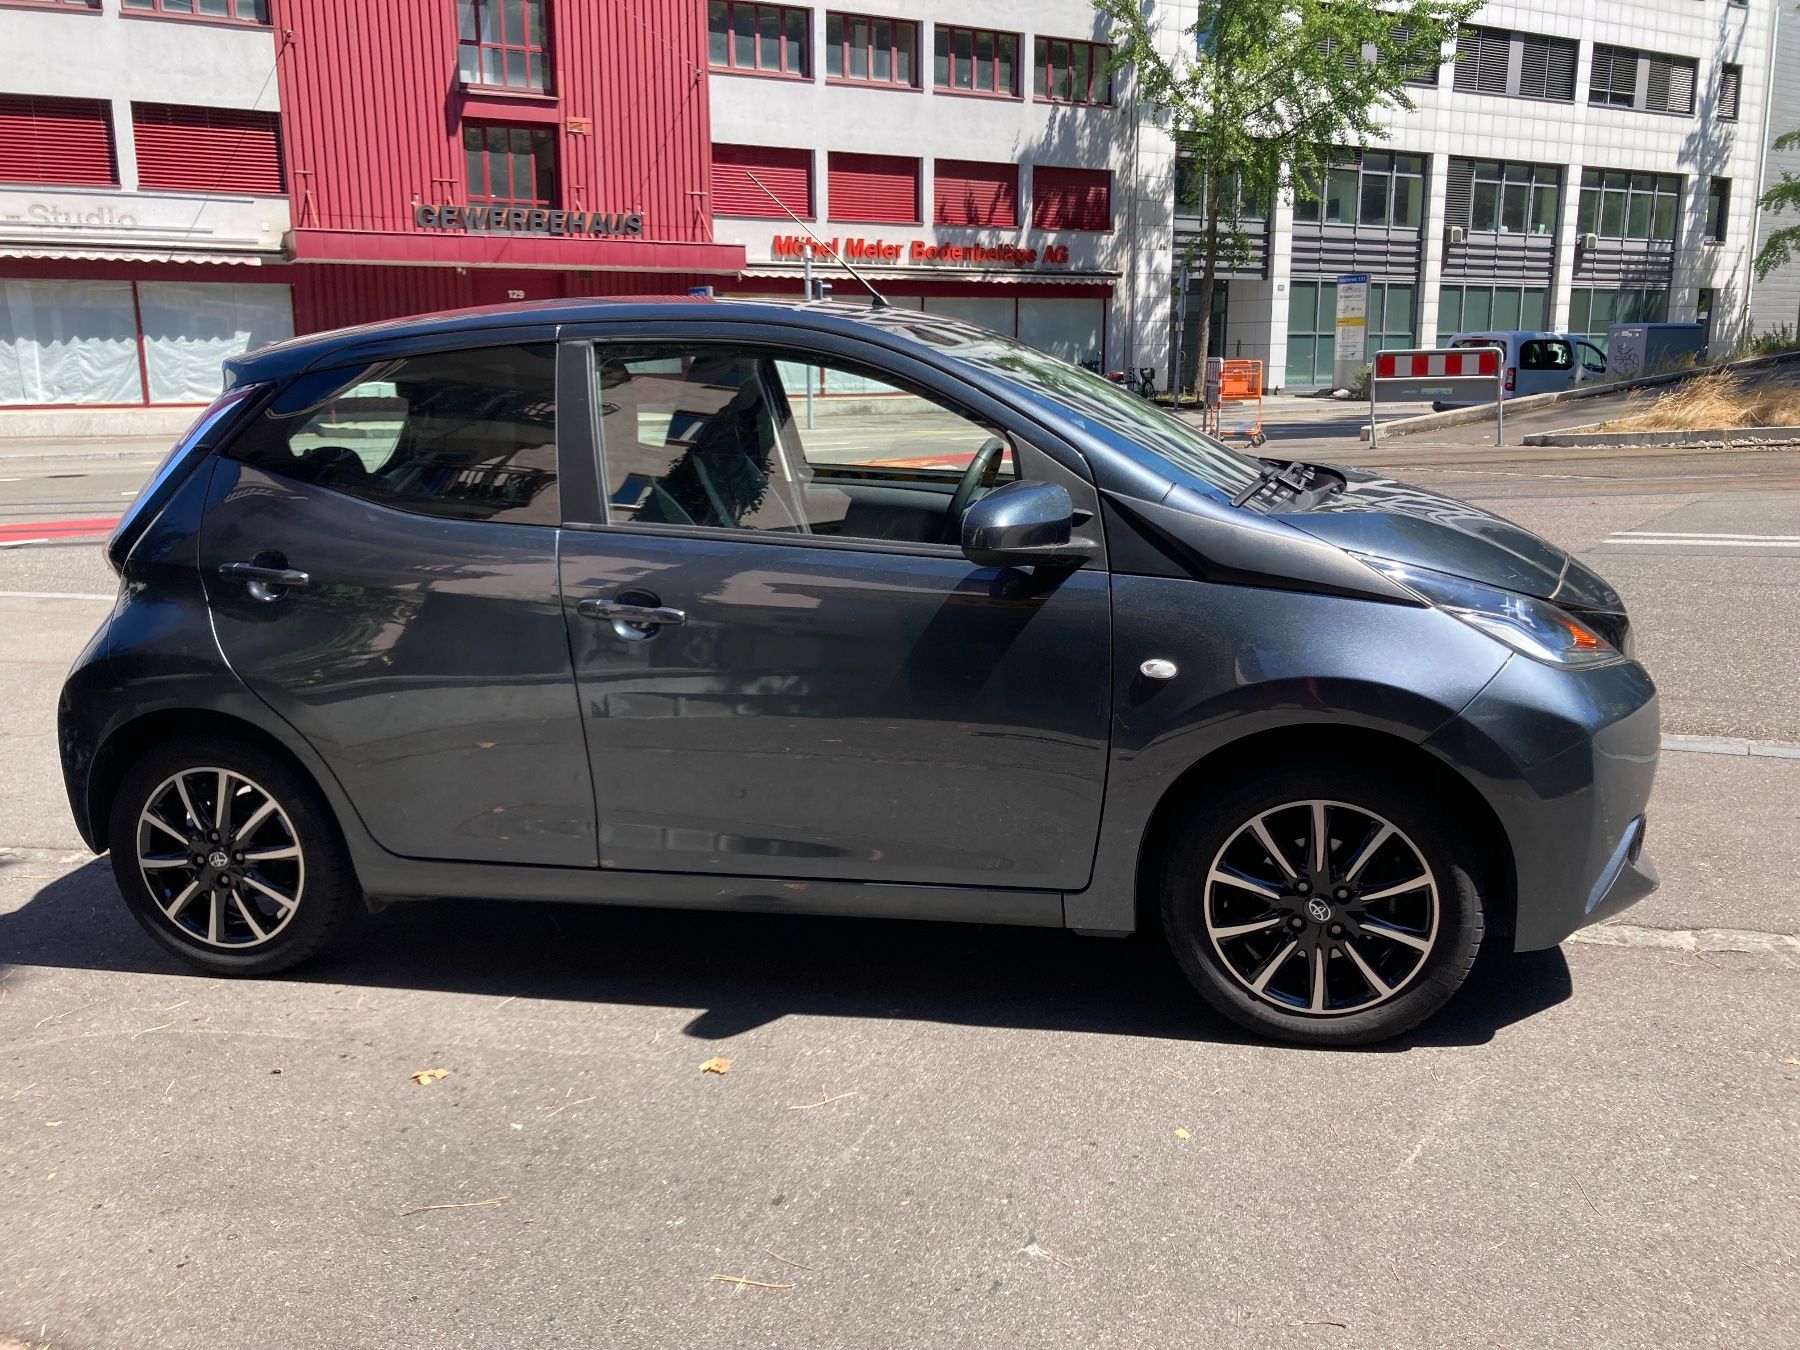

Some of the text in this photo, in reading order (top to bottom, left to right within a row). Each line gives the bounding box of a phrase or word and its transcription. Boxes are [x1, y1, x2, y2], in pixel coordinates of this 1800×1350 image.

[416, 204, 644, 236] GEWERBEHAUS
[773, 235, 1069, 266] Möbel Meier Bodenbeläge AG
[508, 290, 525, 299] 129
